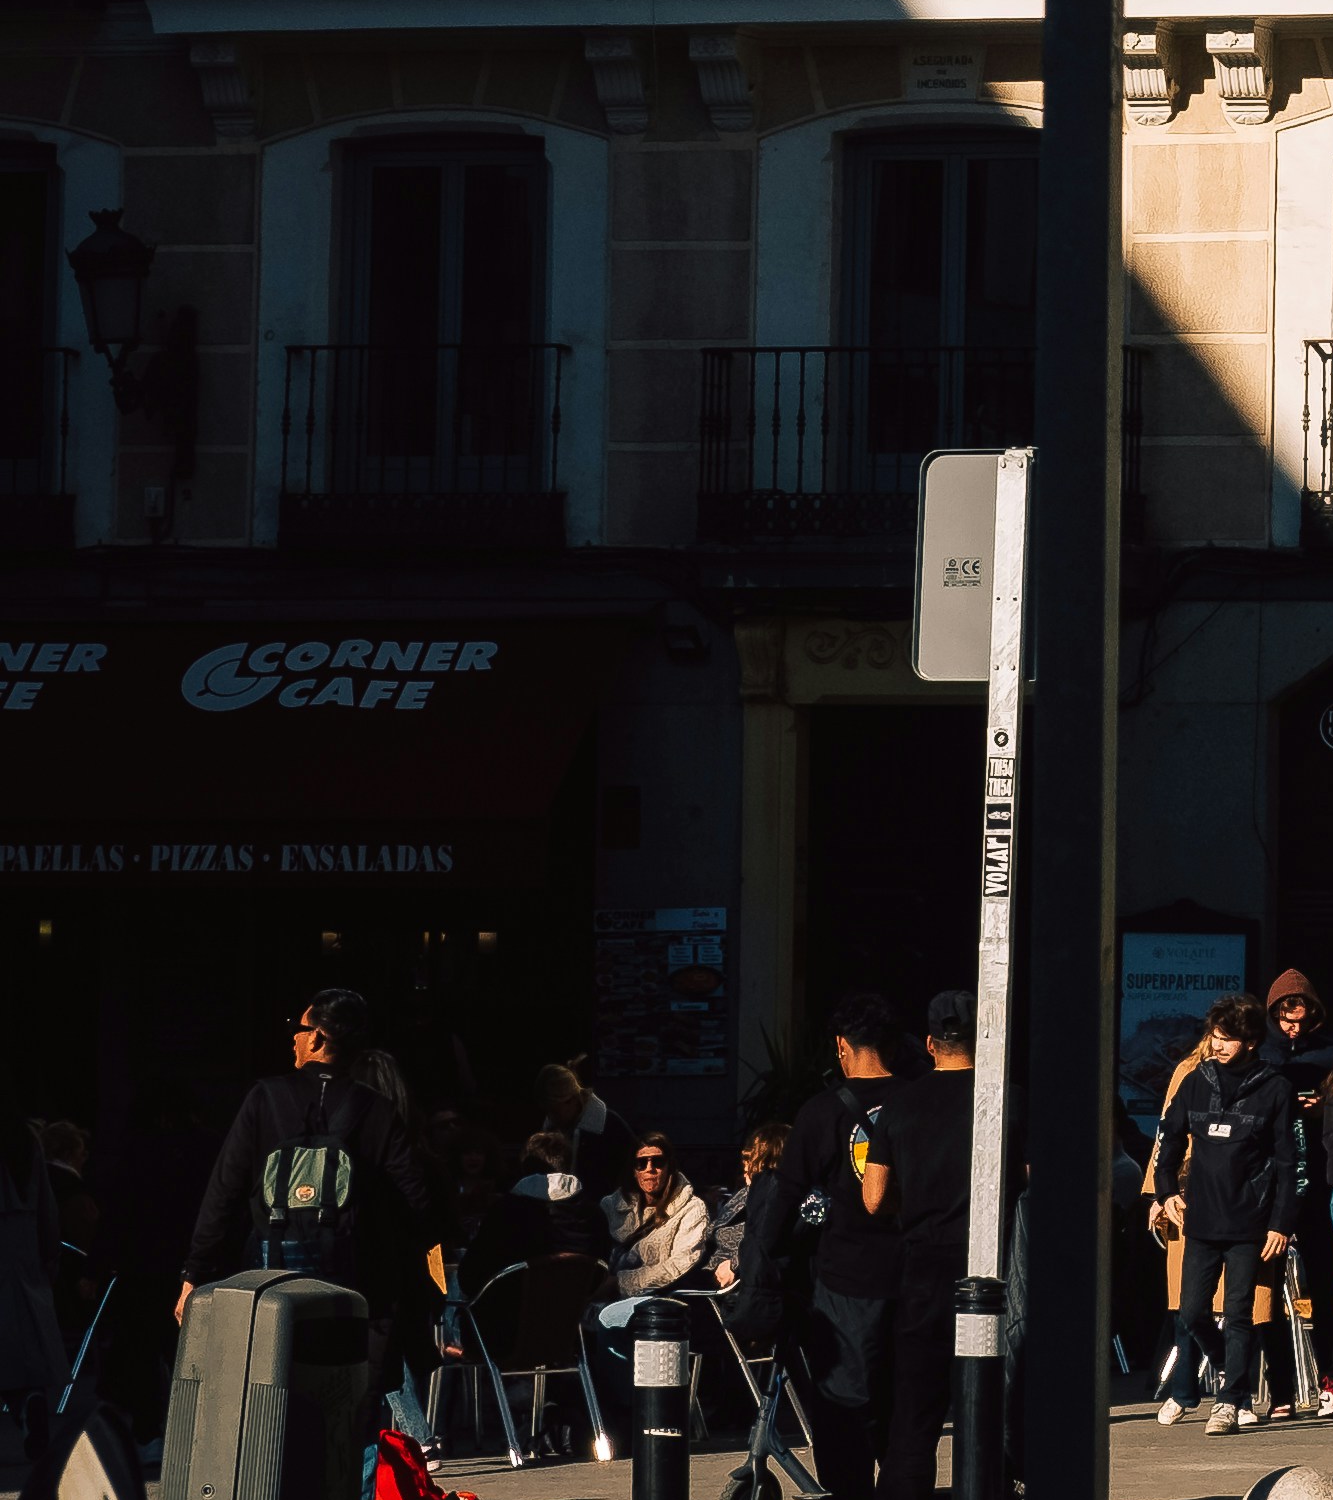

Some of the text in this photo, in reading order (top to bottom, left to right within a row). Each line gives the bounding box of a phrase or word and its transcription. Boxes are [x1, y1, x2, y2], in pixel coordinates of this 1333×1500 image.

[916, 79, 967, 89] INCENDIOS
[247, 638, 499, 673] CORNER
[278, 676, 435, 711] CAFE
[0, 844, 454, 873] PAELLAS PIZZAS ENSALADAS
[1126, 973, 1240, 991] SUPERPAPELONES
